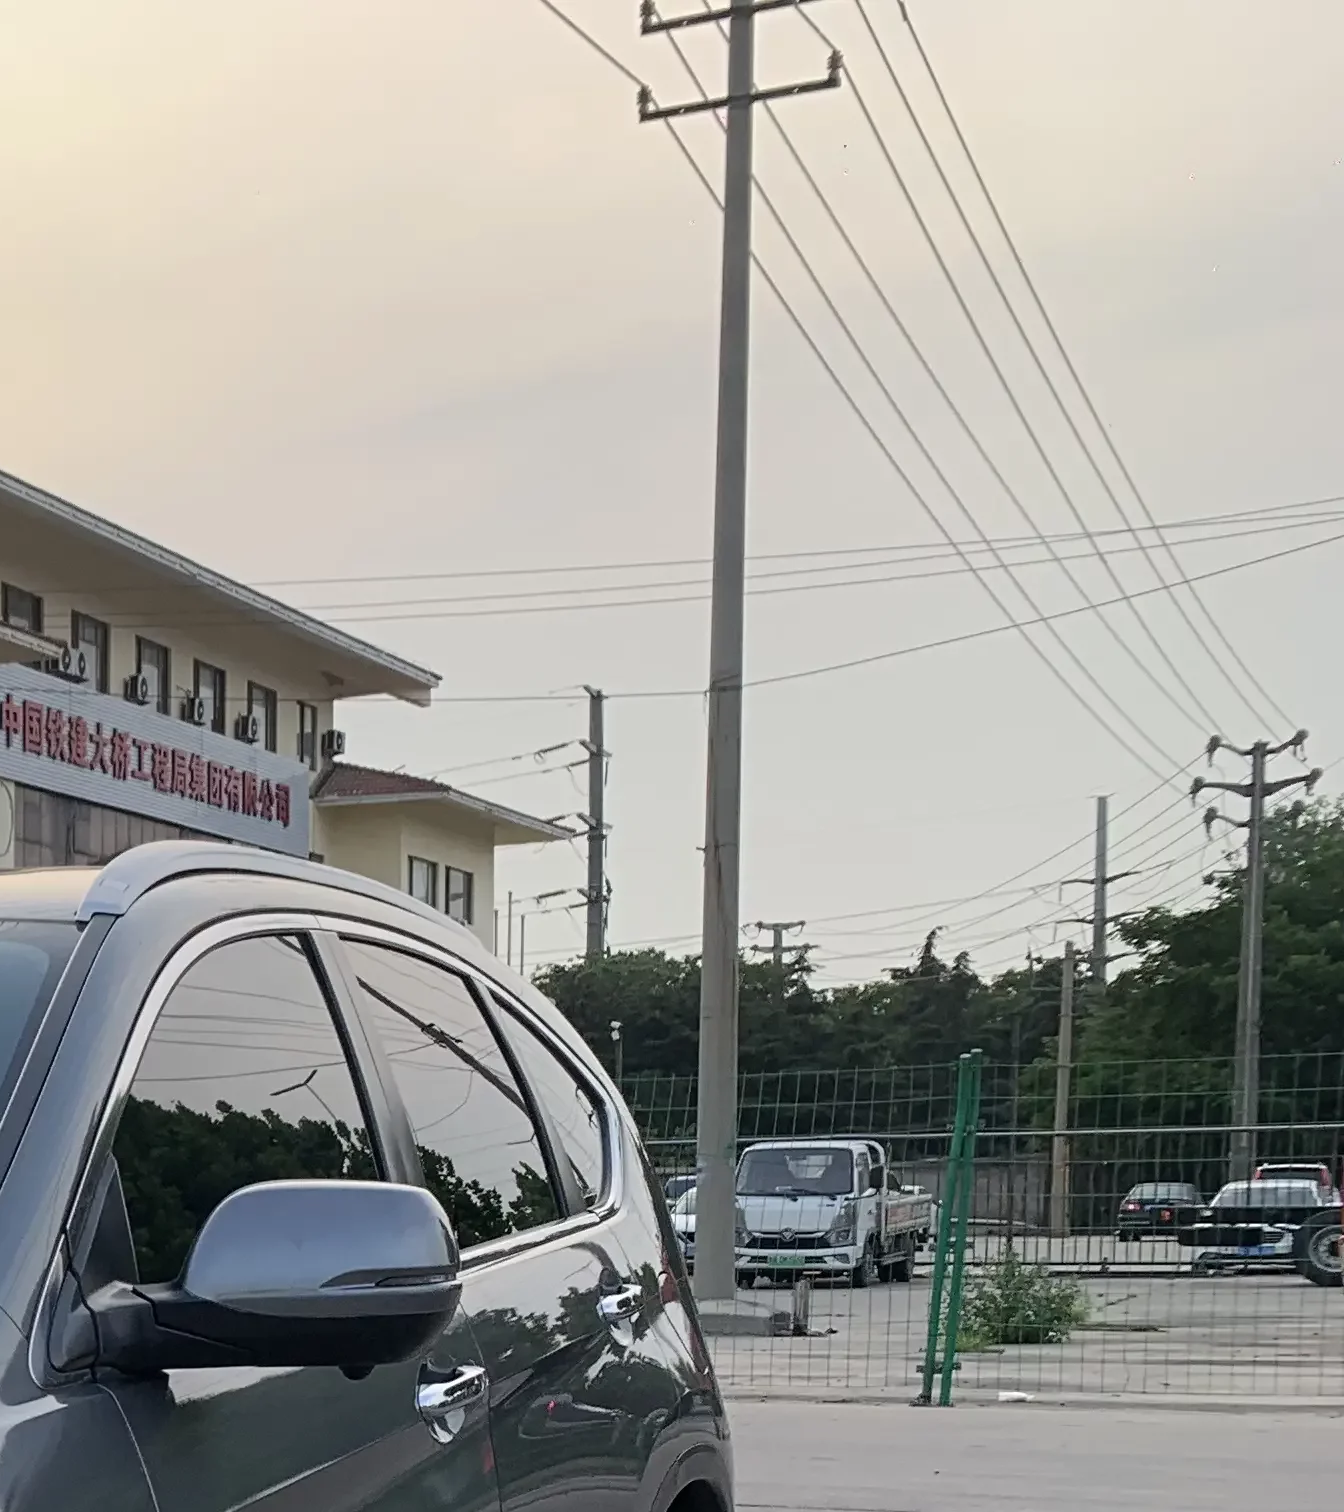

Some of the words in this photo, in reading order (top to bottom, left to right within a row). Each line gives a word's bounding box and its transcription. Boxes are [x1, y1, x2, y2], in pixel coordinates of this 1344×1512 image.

[0, 693, 291, 829] 中国铁建大桥工程局集团有限公司
